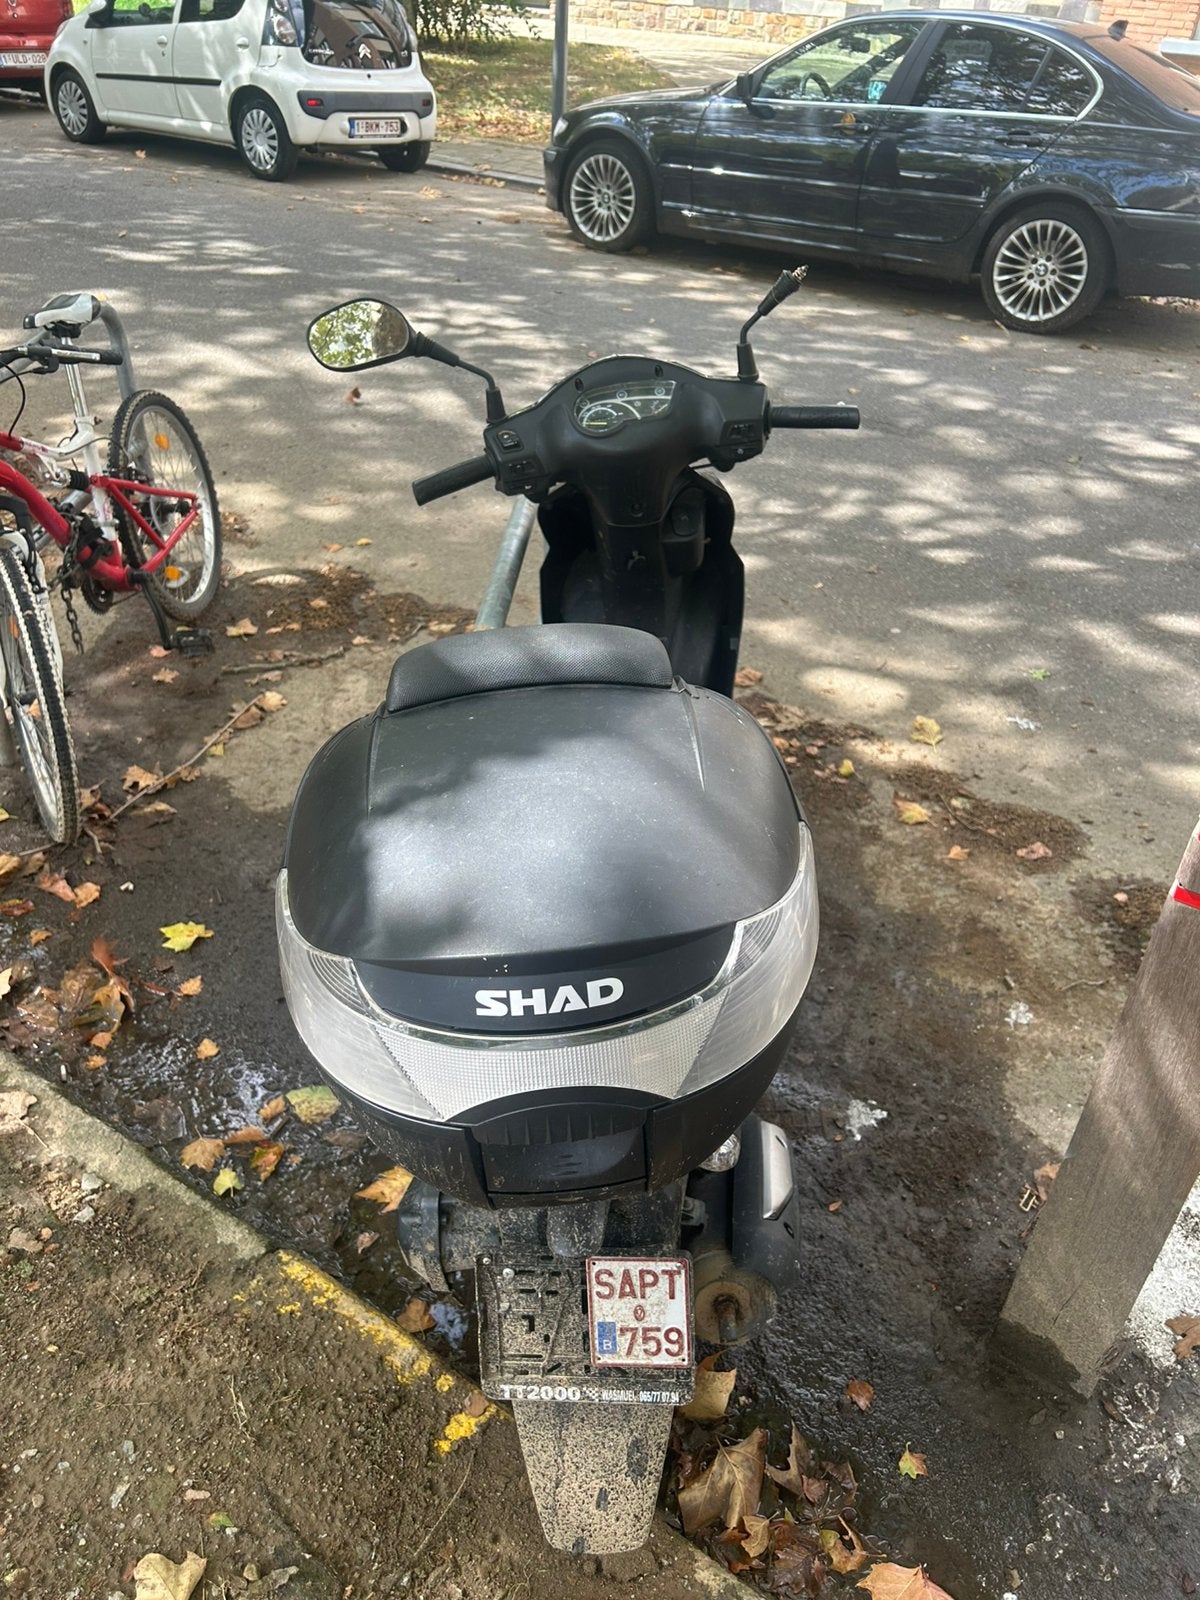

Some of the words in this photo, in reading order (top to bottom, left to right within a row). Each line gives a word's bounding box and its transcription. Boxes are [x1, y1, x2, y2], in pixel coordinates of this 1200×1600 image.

[474, 977, 625, 1017] SHAD
[594, 1268, 681, 1300] SAPT
[603, 1339, 612, 1350] B
[619, 1326, 684, 1358] 759
[499, 1384, 581, 1401] TT2000
